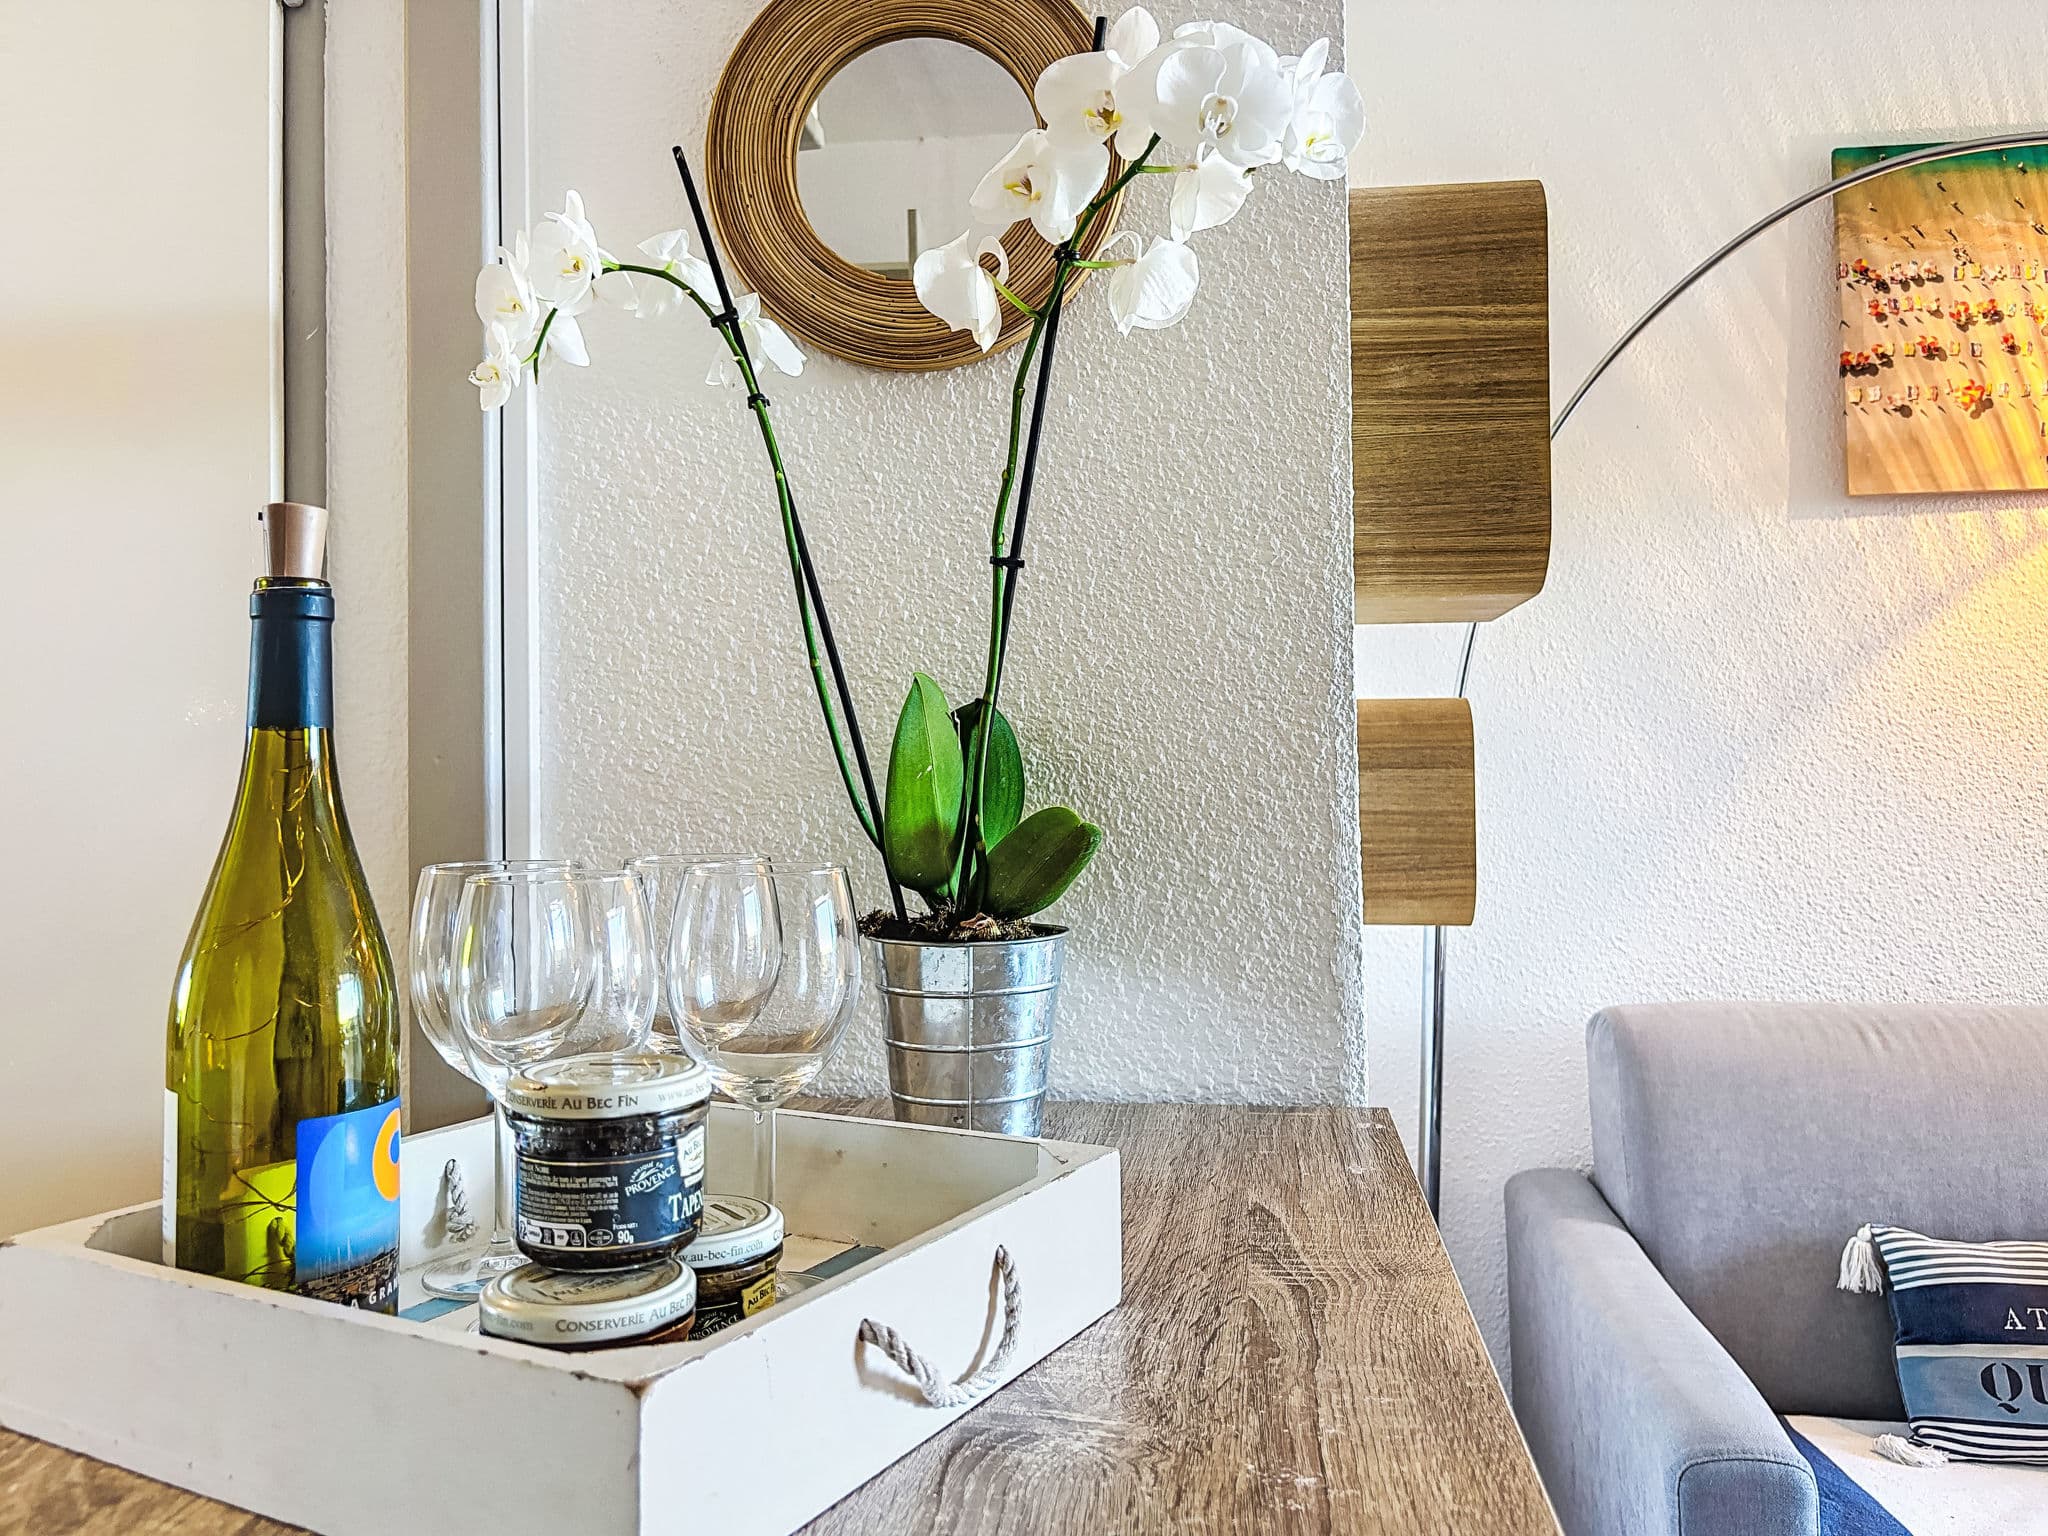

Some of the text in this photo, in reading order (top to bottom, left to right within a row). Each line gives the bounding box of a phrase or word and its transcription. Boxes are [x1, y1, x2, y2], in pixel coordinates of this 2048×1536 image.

[624, 1164, 677, 1197] PROVENCE
[617, 1229, 634, 1244] 90g
[679, 1239, 763, 1263] w.au-bec-fin.com
[2004, 1307, 2048, 1330] AT
